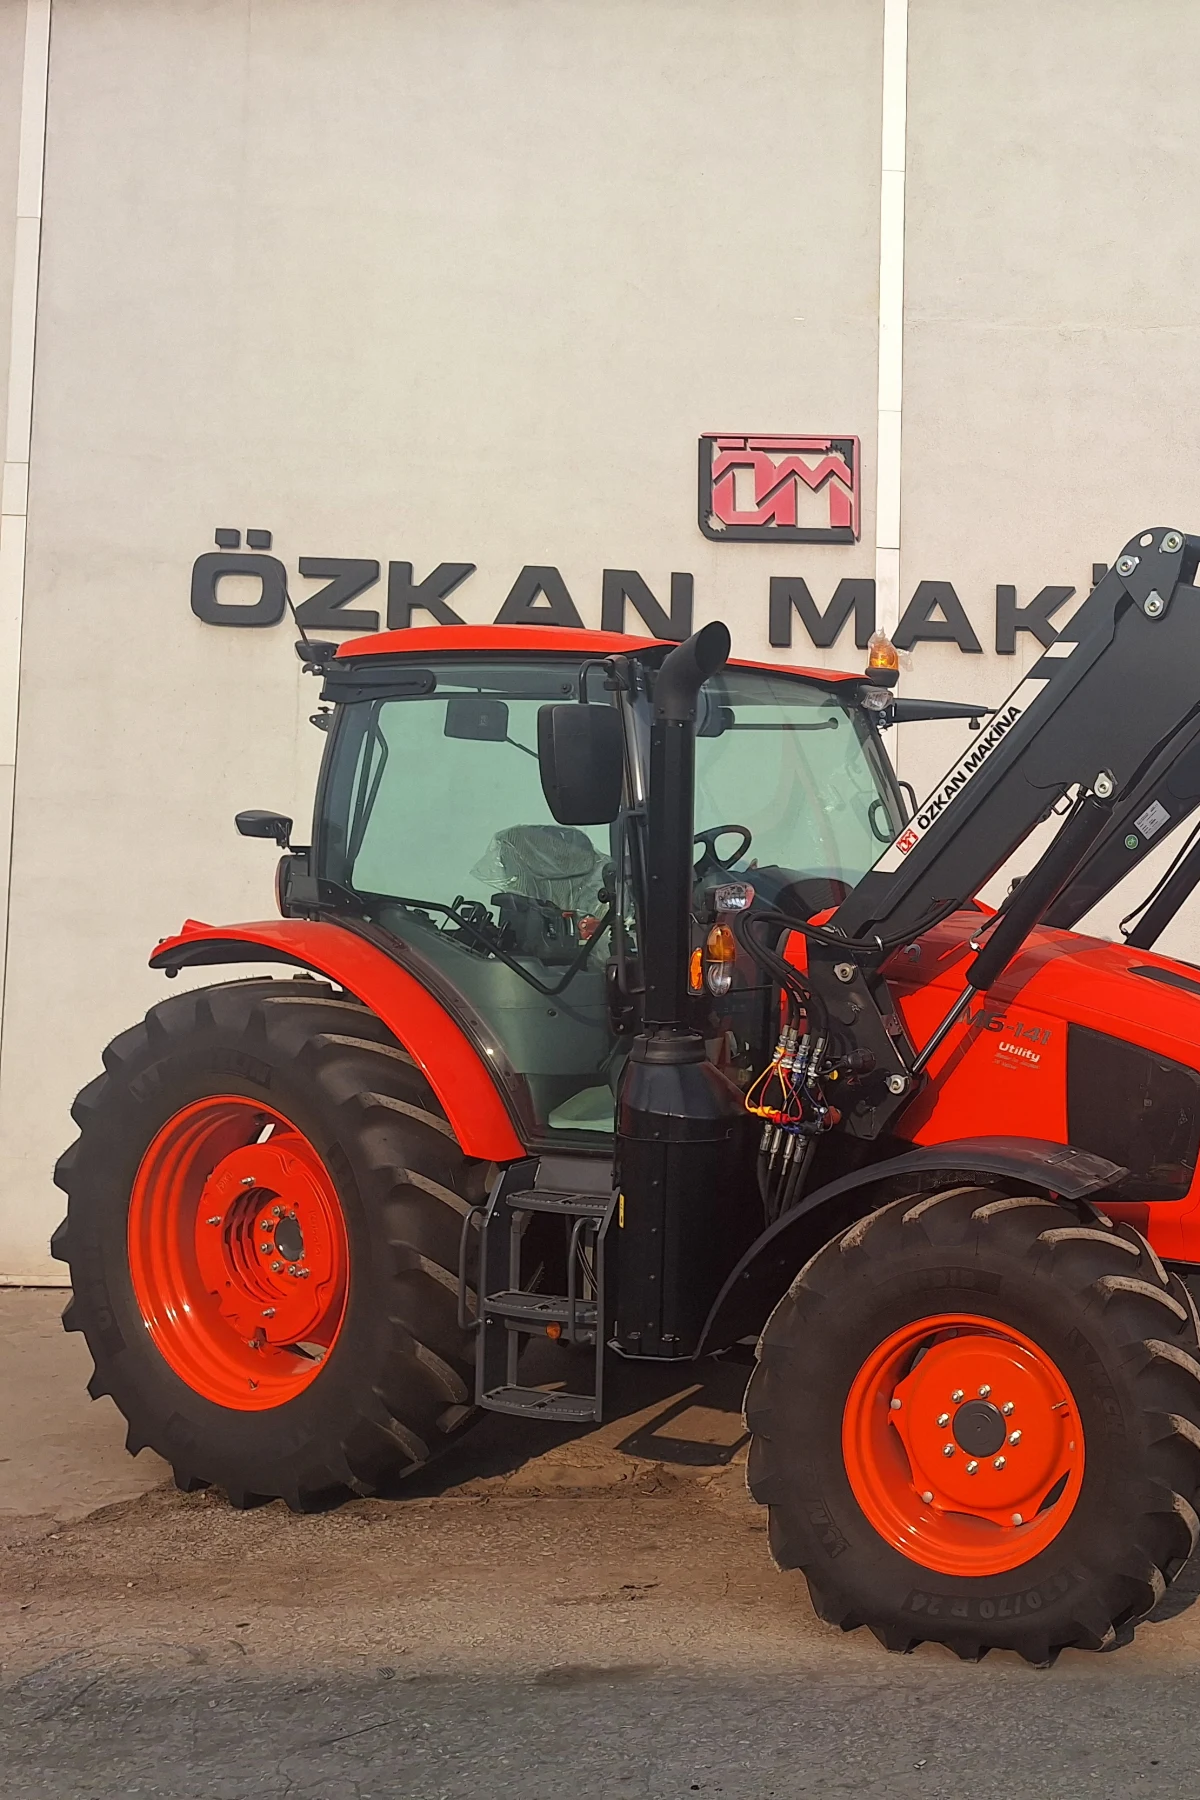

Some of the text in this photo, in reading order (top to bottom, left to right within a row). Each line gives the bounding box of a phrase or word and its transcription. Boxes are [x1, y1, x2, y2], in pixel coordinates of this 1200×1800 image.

[190, 527, 1108, 655] ÖZKAN MAK
[917, 770, 967, 831] ÖZKAN
[963, 706, 1023, 774] MAKİNA
[998, 1041, 1041, 1063] Utility
